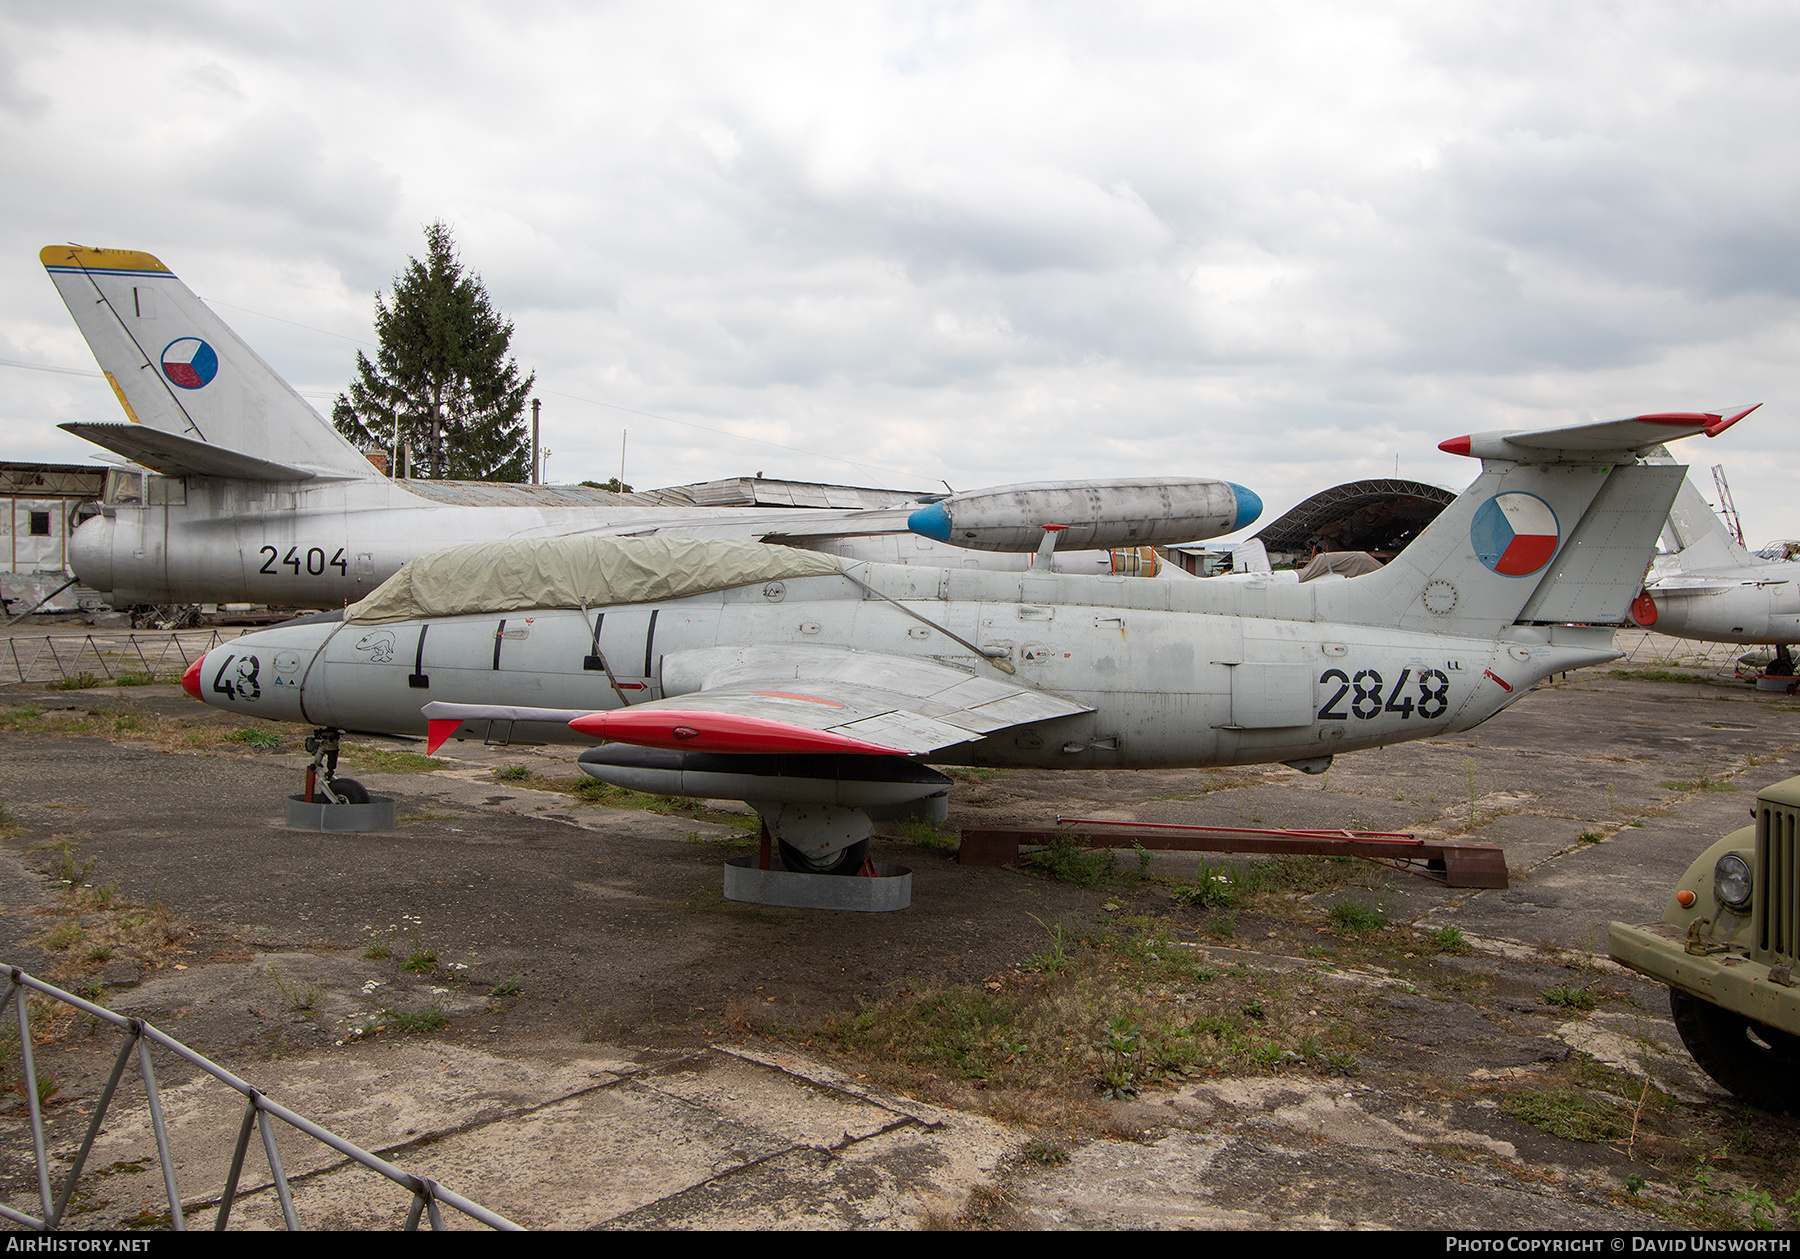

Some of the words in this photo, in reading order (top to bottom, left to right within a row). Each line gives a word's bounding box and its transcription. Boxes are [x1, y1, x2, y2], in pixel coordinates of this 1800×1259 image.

[259, 545, 348, 577] 2404
[213, 654, 261, 702] 48
[1317, 668, 1450, 720] 2848
